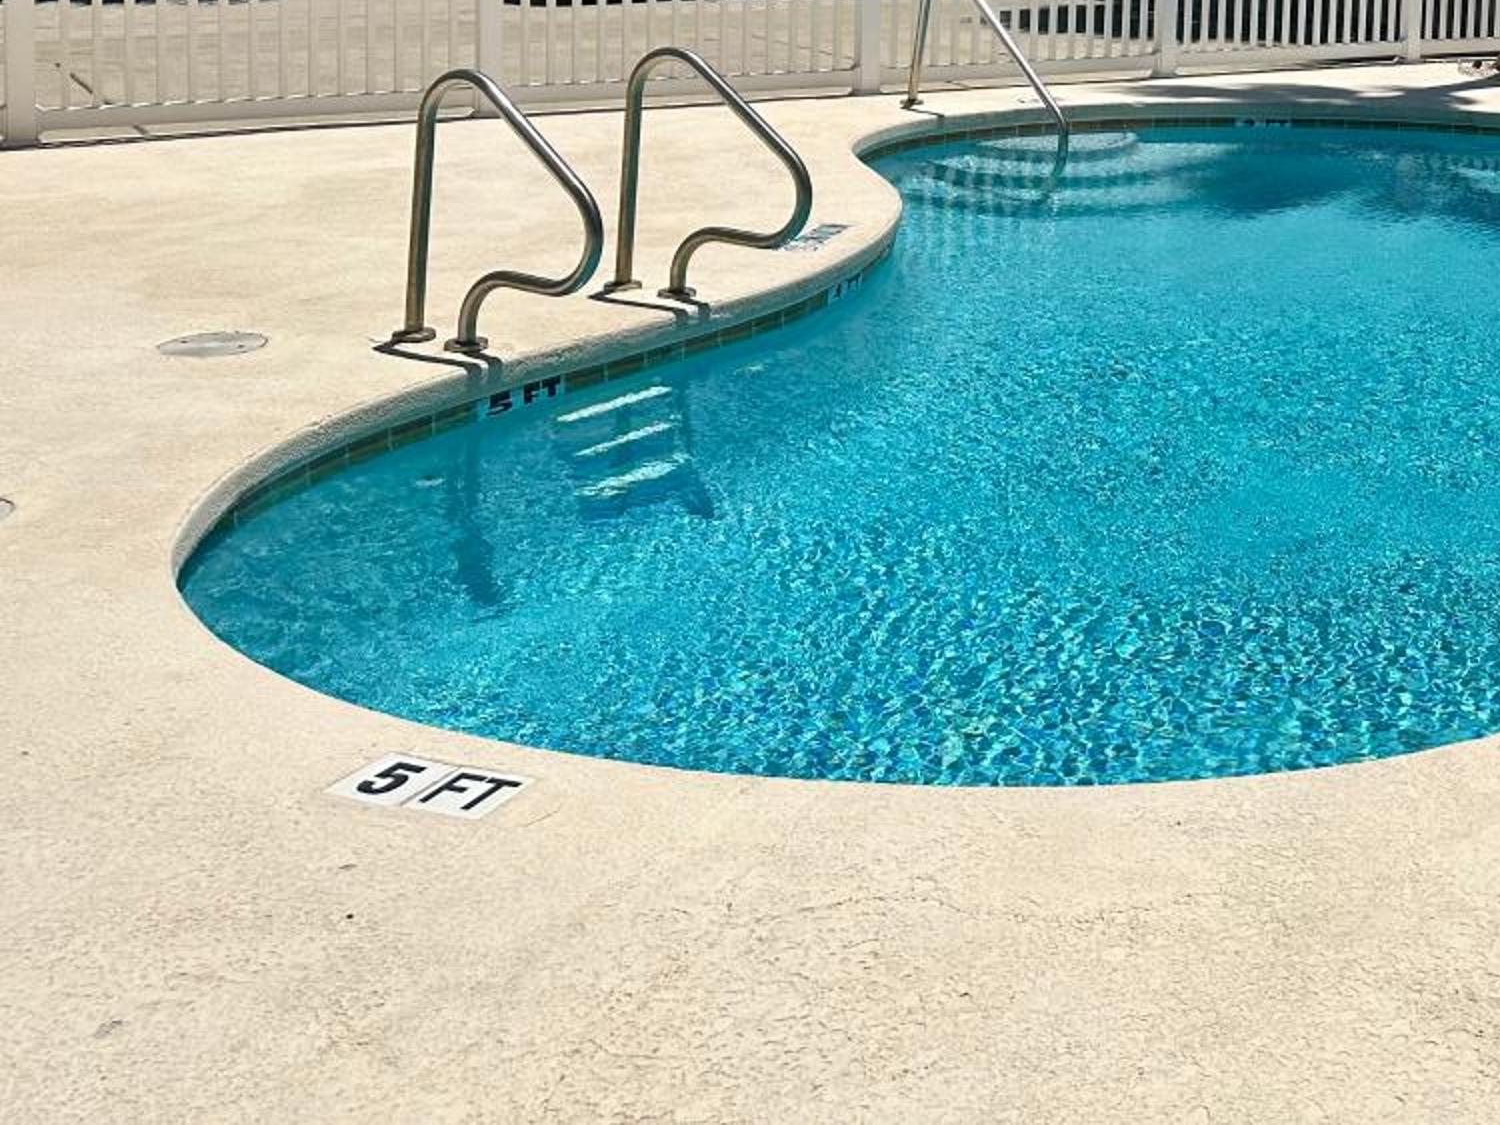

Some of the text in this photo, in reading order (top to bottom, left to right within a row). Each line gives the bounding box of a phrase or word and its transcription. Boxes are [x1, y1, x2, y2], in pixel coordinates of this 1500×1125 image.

[486, 376, 562, 416] 5 FT
[356, 762, 523, 811] 5 FT
